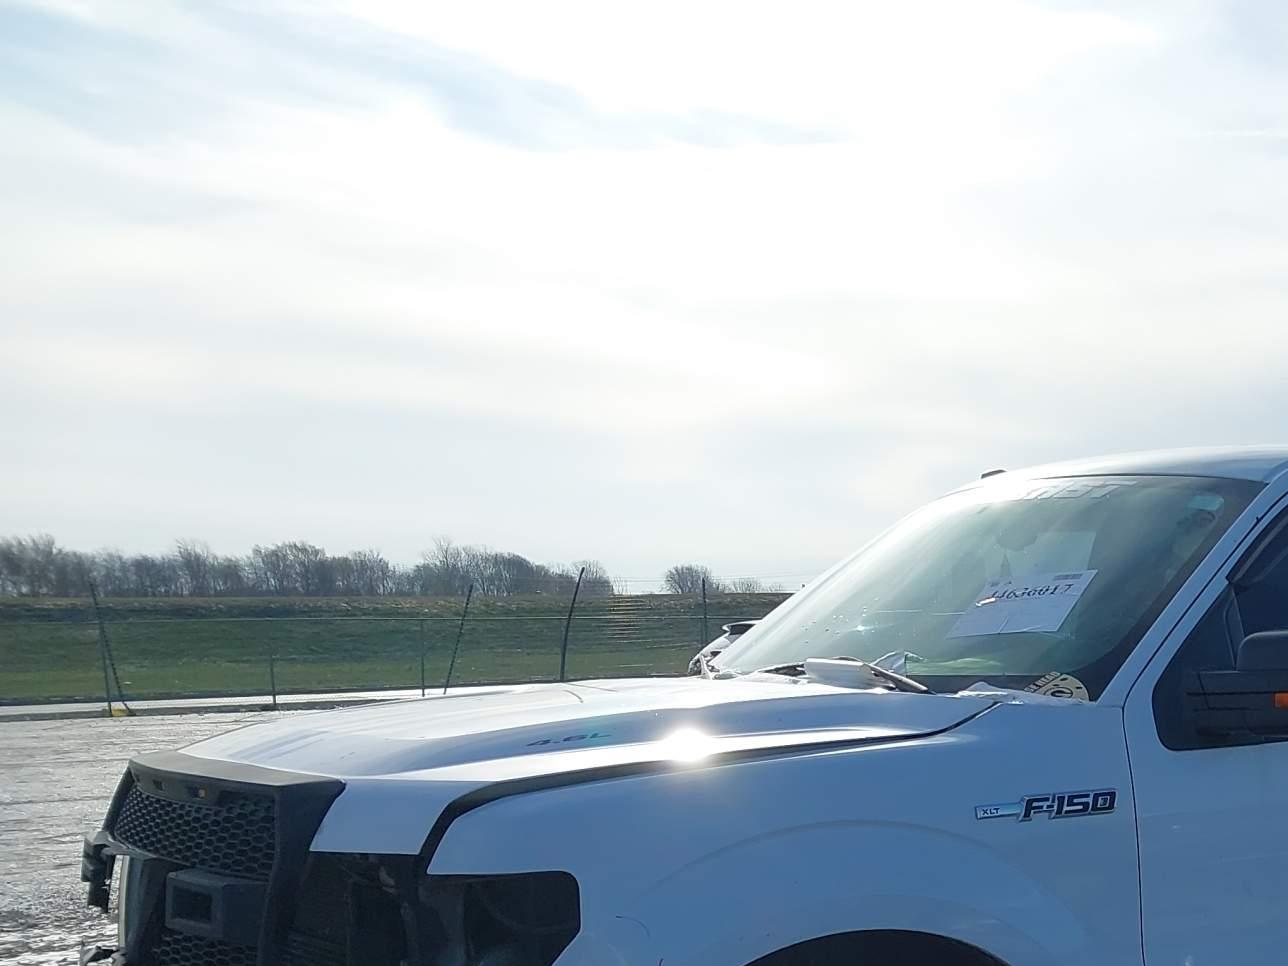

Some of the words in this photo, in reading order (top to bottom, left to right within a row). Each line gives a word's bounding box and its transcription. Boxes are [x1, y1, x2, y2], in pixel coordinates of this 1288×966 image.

[527, 733, 612, 746] 4.6L
[981, 807, 1001, 816] XLT
[1021, 791, 1117, 821] F-150
